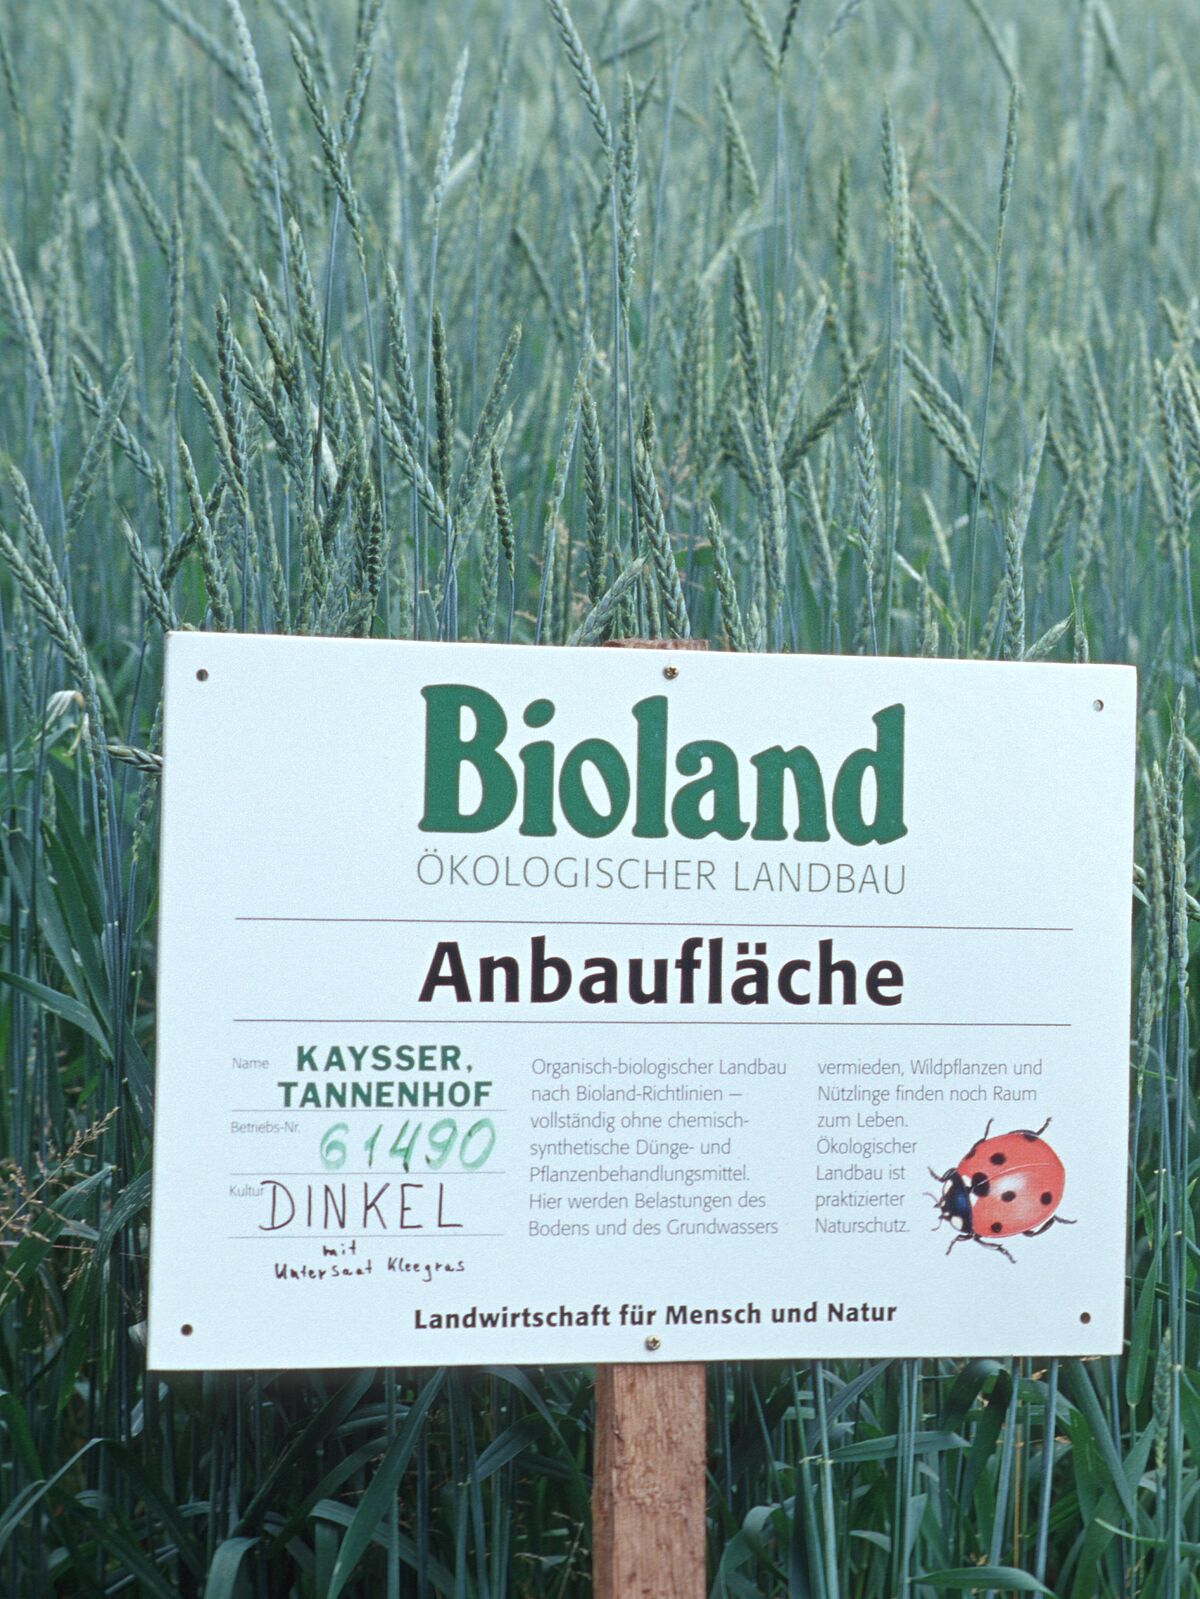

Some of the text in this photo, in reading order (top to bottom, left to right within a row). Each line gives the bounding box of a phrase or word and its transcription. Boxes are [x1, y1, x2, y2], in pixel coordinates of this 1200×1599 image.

[418, 684, 908, 846] Bioland
[417, 848, 907, 895] ÖKOLOGISCHER LANDBAU
[418, 936, 903, 1006] Anbaufläche
[233, 1057, 269, 1069] Name
[297, 1045, 472, 1073] KAYSSER,
[532, 1057, 786, 1079] Organisch-biologischer Landbau
[818, 1058, 1042, 1078] vermieden, Wildpflanzen und
[278, 1081, 492, 1108] TANNENHOF
[532, 1085, 569, 1101] nach
[577, 1084, 722, 1101] Bioland-Richtlinien
[819, 1085, 1036, 1106] Nützlinge finden noch Raum
[231, 1121, 301, 1133] Betriebs-Nr.
[531, 1111, 749, 1133] vollständig ohne chemisch-
[818, 1111, 908, 1127] zum Leben.
[320, 1118, 496, 1171] 61490
[530, 1138, 731, 1160] synthetische Dünge- und
[817, 1136, 917, 1158] Ökologischer
[530, 1164, 749, 1186] Pflanzenbehandlungsmittel.
[817, 1164, 905, 1180] Landbau ist
[259, 1180, 464, 1231] DINKEL
[530, 1191, 765, 1212] Hier werden Belastungen des
[816, 1191, 905, 1211] praktizierter
[529, 1218, 778, 1236] Bodens und des Grundwassers
[816, 1217, 909, 1233] Naturschutz.
[323, 1240, 356, 1256] mit
[388, 1257, 464, 1282] Kleegras
[415, 1301, 897, 1329] Landwirtschaft für Mensch und Natur
